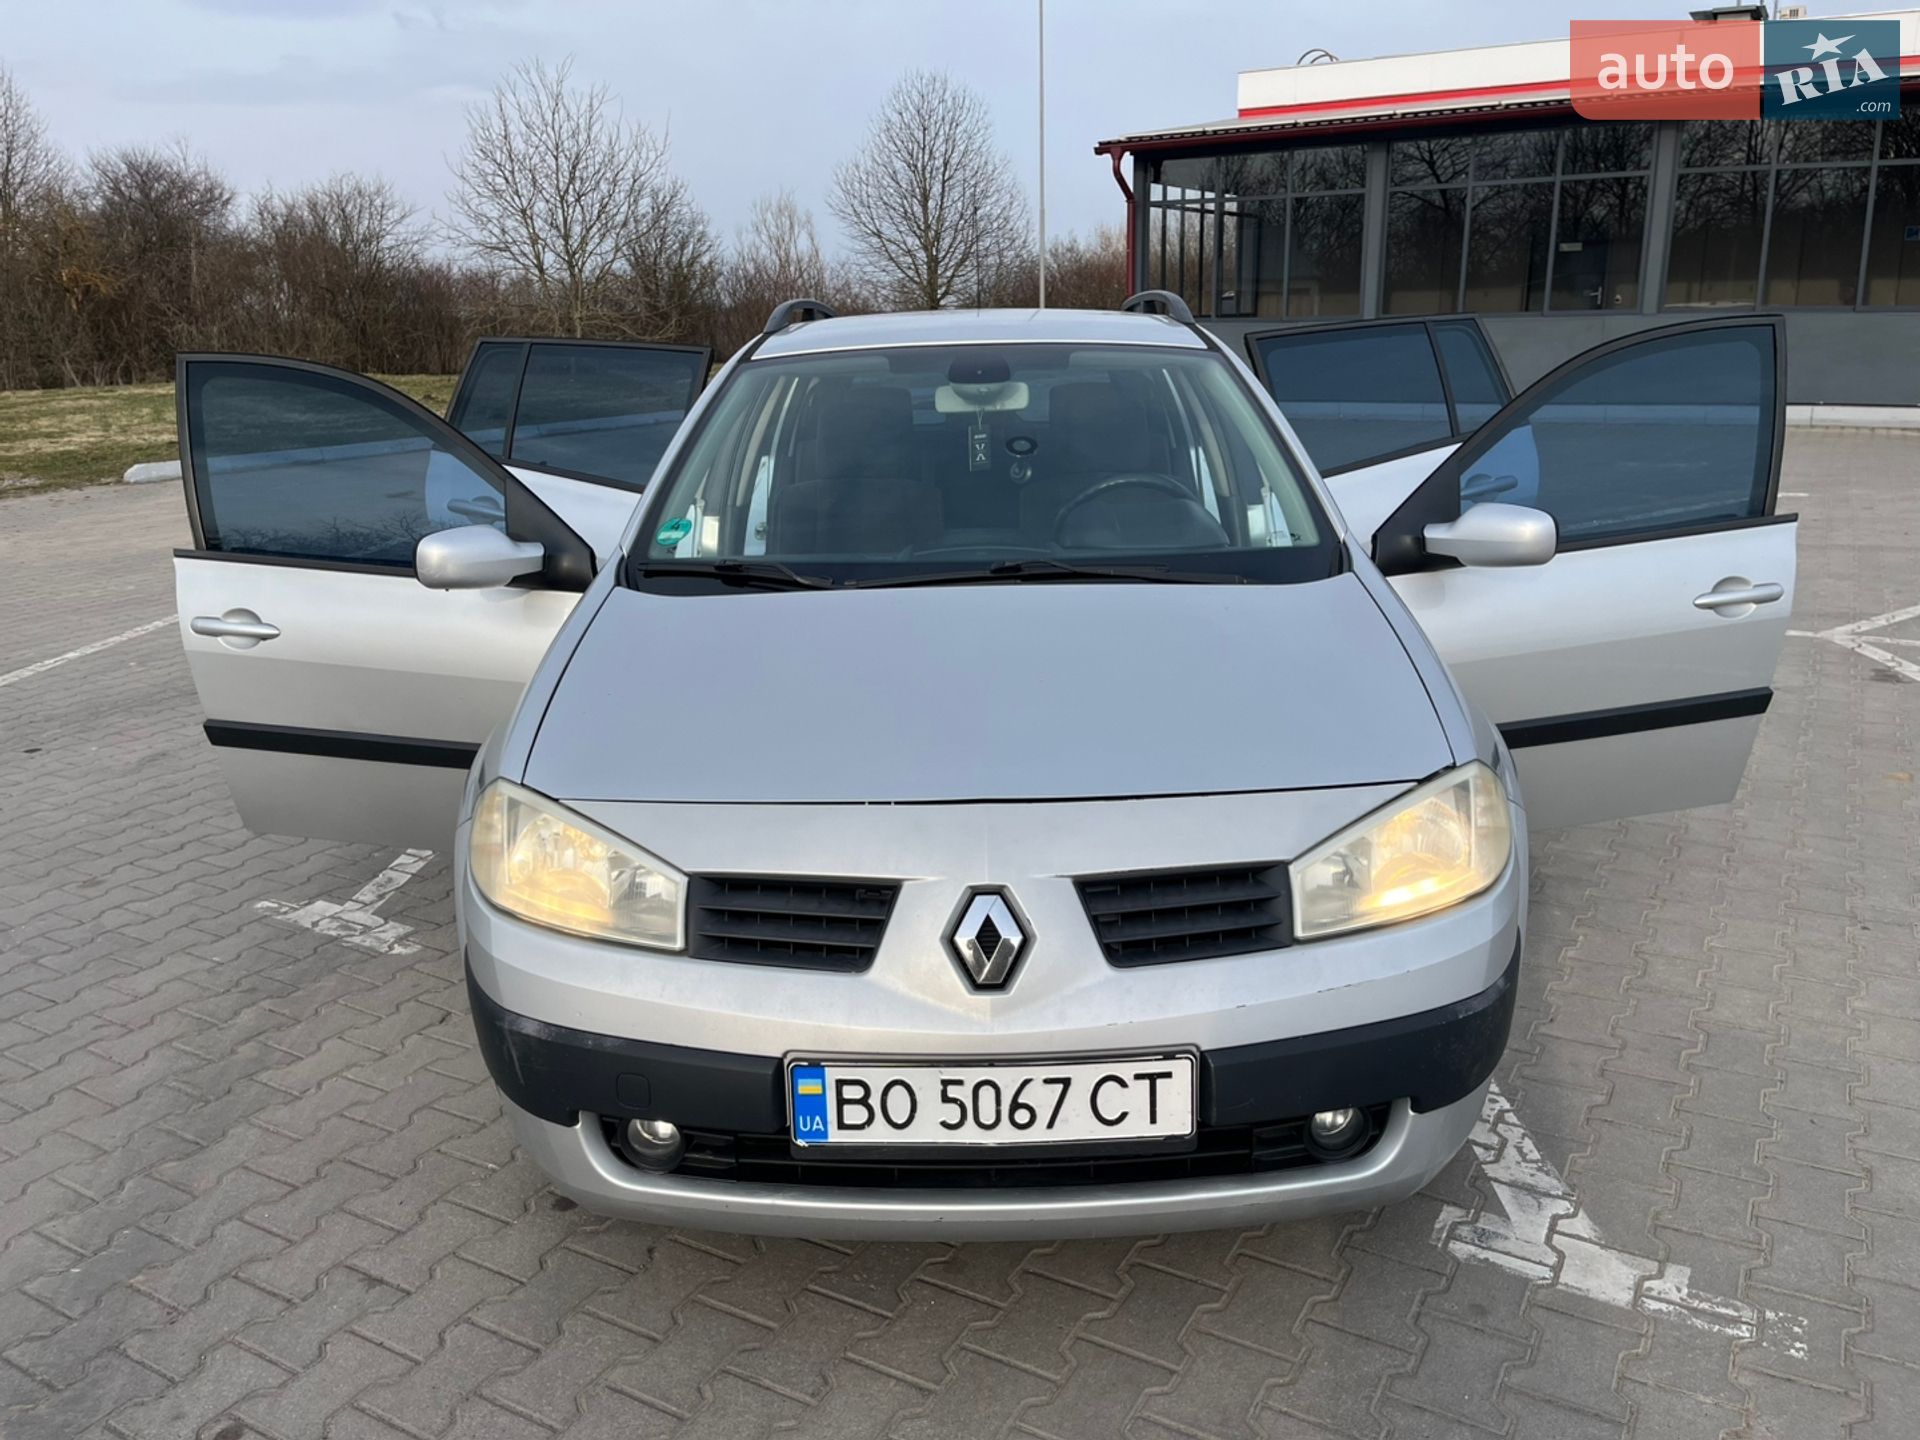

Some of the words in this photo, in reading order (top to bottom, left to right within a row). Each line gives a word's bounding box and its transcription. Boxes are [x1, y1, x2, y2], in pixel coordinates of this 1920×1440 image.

[835, 1078, 917, 1130] BO
[939, 1076, 1071, 1131] 5067
[1090, 1071, 1173, 1127] CT
[799, 1115, 825, 1132] UA
